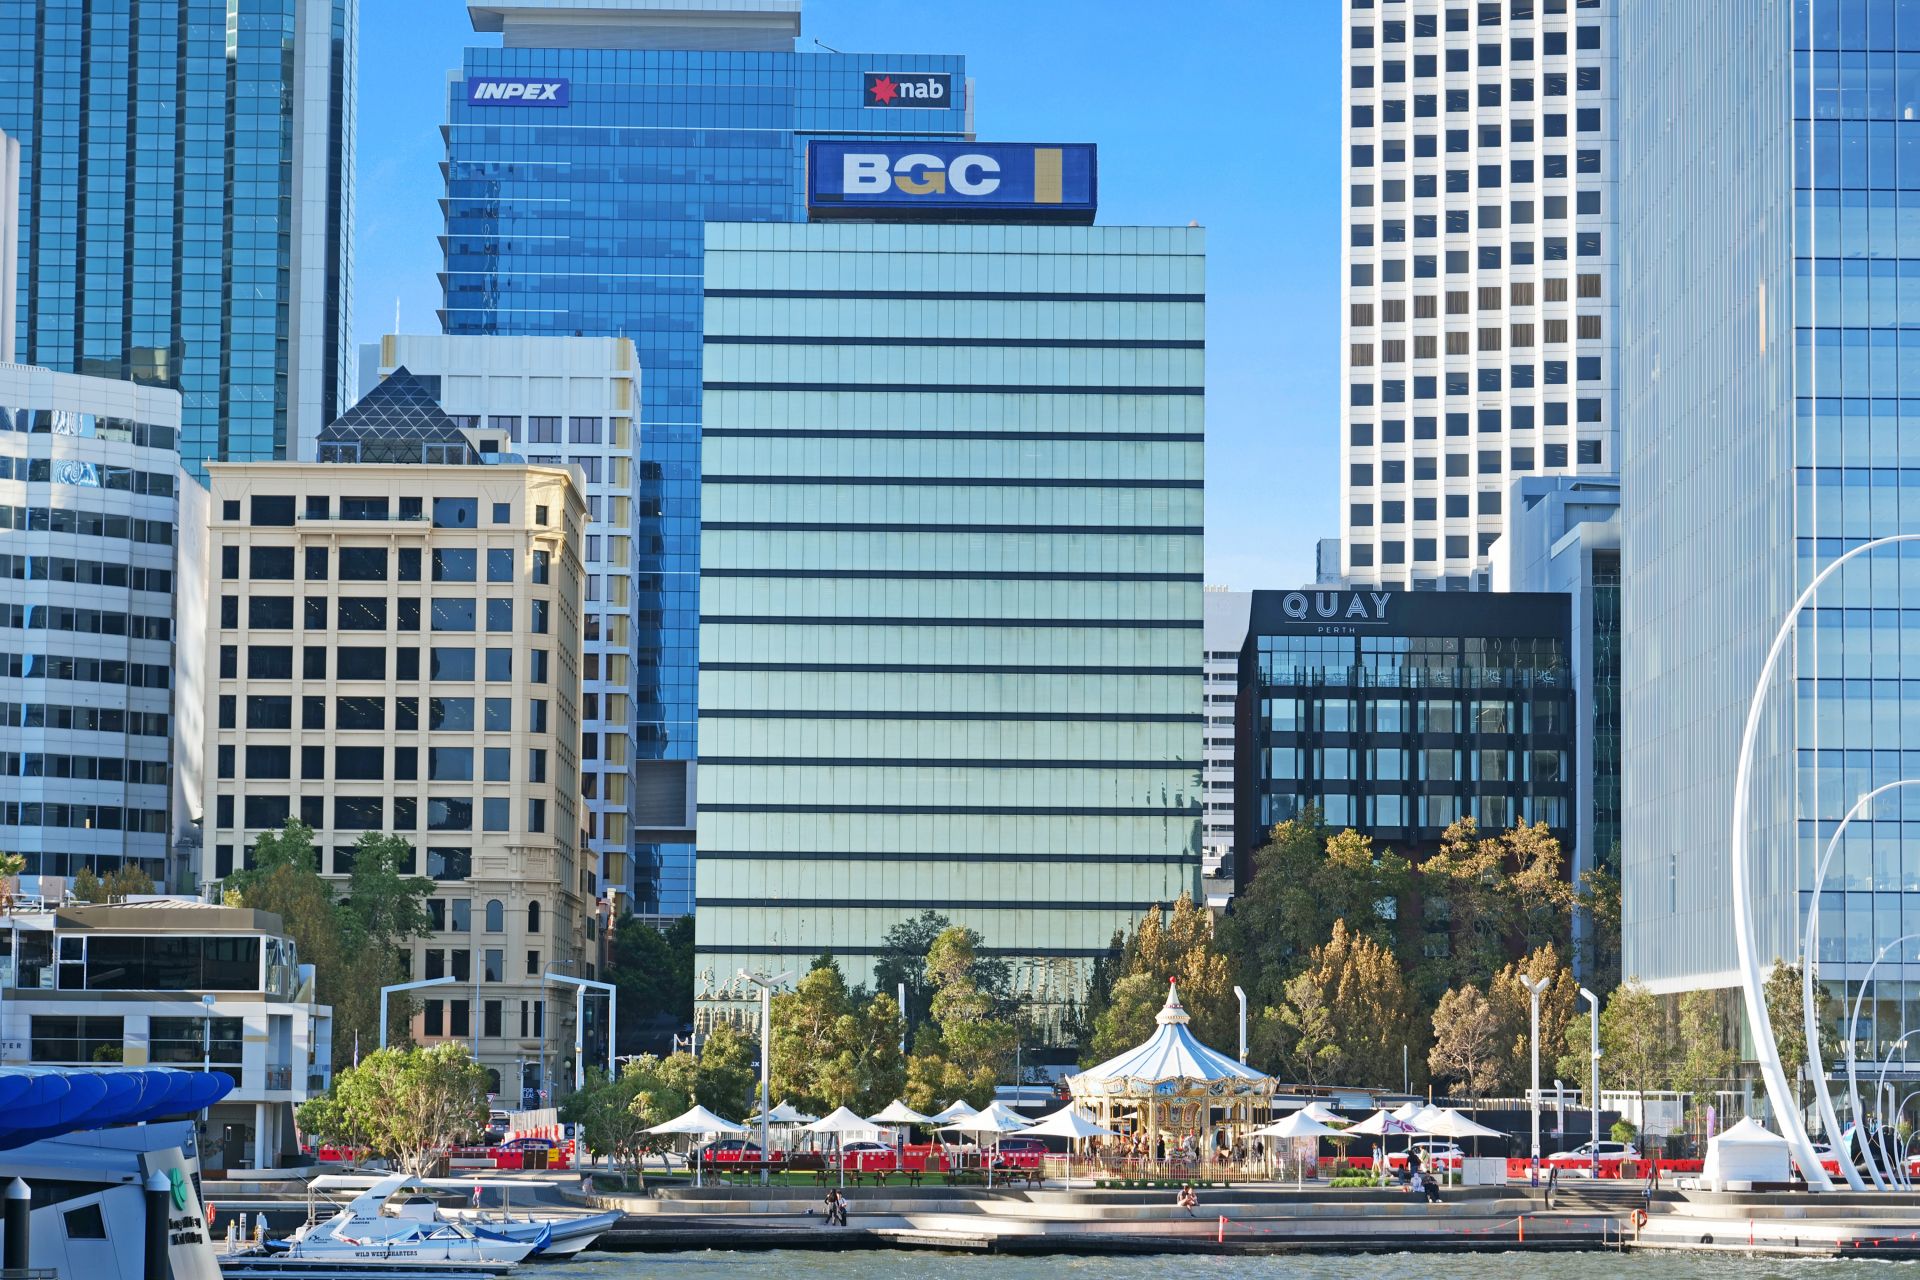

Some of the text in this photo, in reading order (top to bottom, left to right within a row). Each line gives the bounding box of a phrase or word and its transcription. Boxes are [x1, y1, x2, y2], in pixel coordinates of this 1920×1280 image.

[474, 83, 561, 100] INPEX
[900, 78, 944, 98] nab
[843, 153, 1001, 196] BGC
[1282, 592, 1392, 620] QUAY
